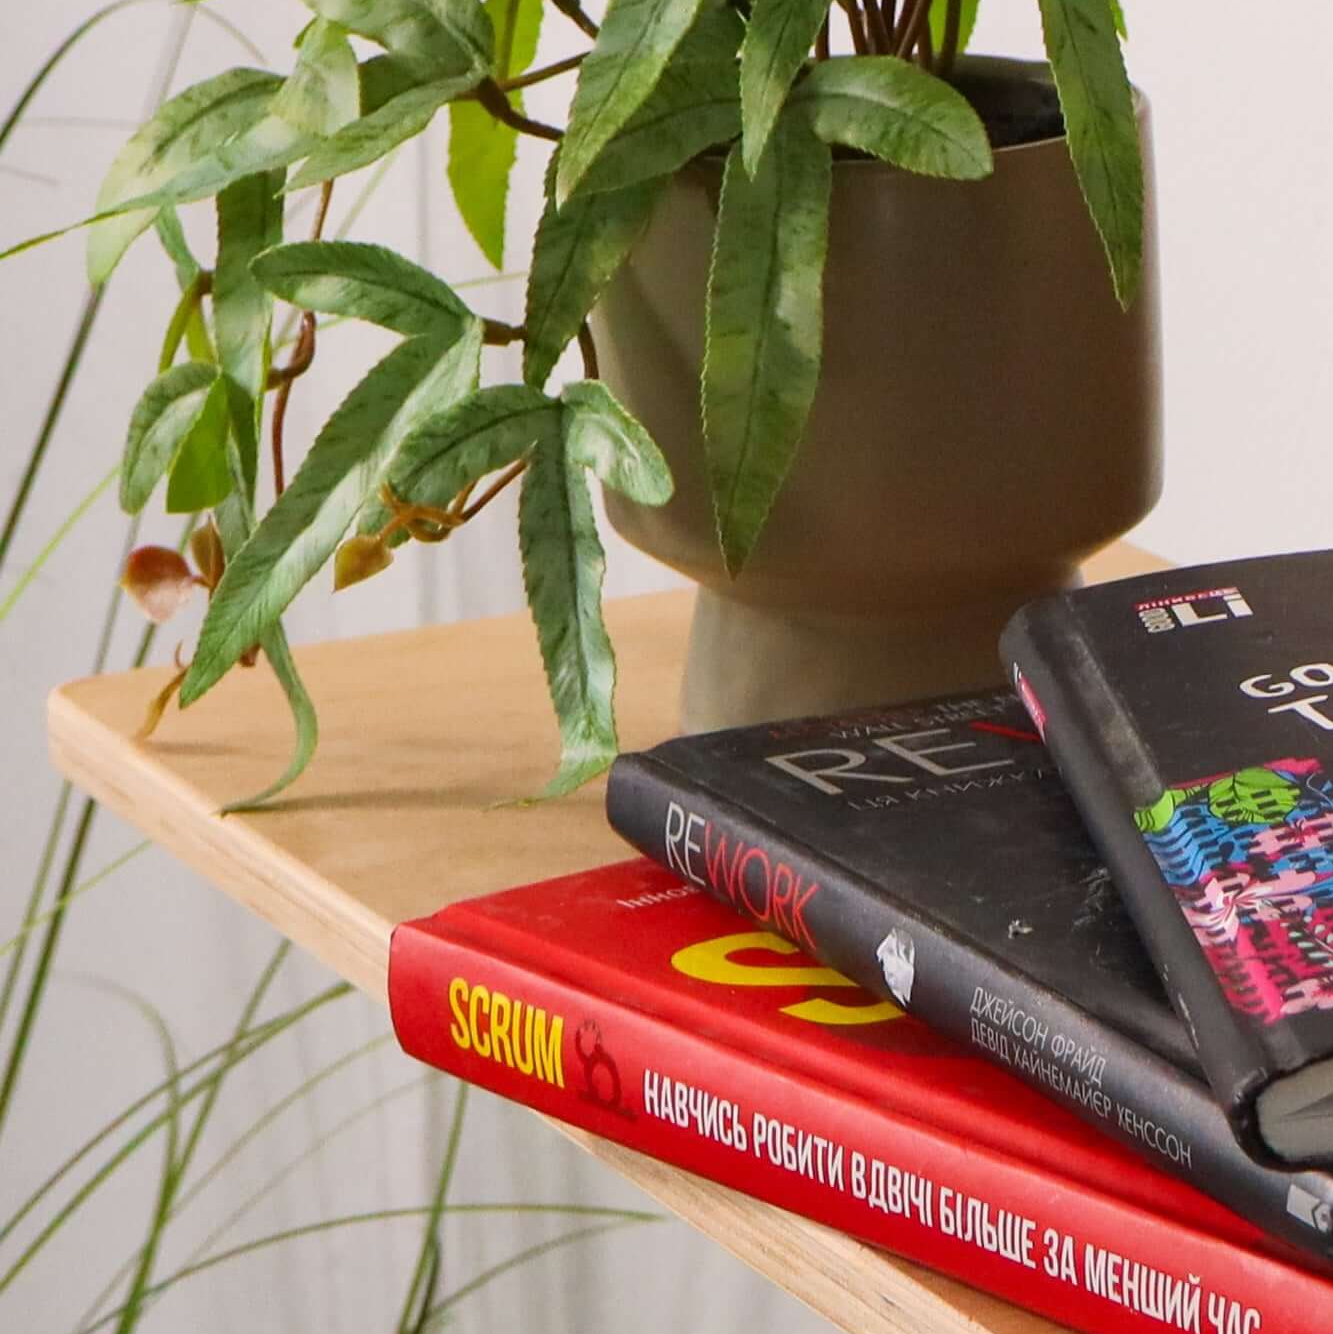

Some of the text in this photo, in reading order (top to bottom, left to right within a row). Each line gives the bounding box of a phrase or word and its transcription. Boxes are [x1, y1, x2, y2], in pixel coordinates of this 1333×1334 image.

[665, 801, 821, 955] REWORK
[449, 977, 565, 1089] SCRUM
[969, 986, 1107, 1088] ДЖЕЙСОН ФРАЙД
[971, 1017, 1193, 1169] ДЕВІД ХАЙНЕМАЙЄР ХЕНССОН
[643, 1068, 749, 1153] НАВЧИСЬ
[752, 1111, 845, 1192] РОБИТИ
[851, 1150, 933, 1228] ВДВІЧІ
[939, 1186, 1037, 1269] БІЛЬШЕ
[1043, 1227, 1078, 1286] ЗА
